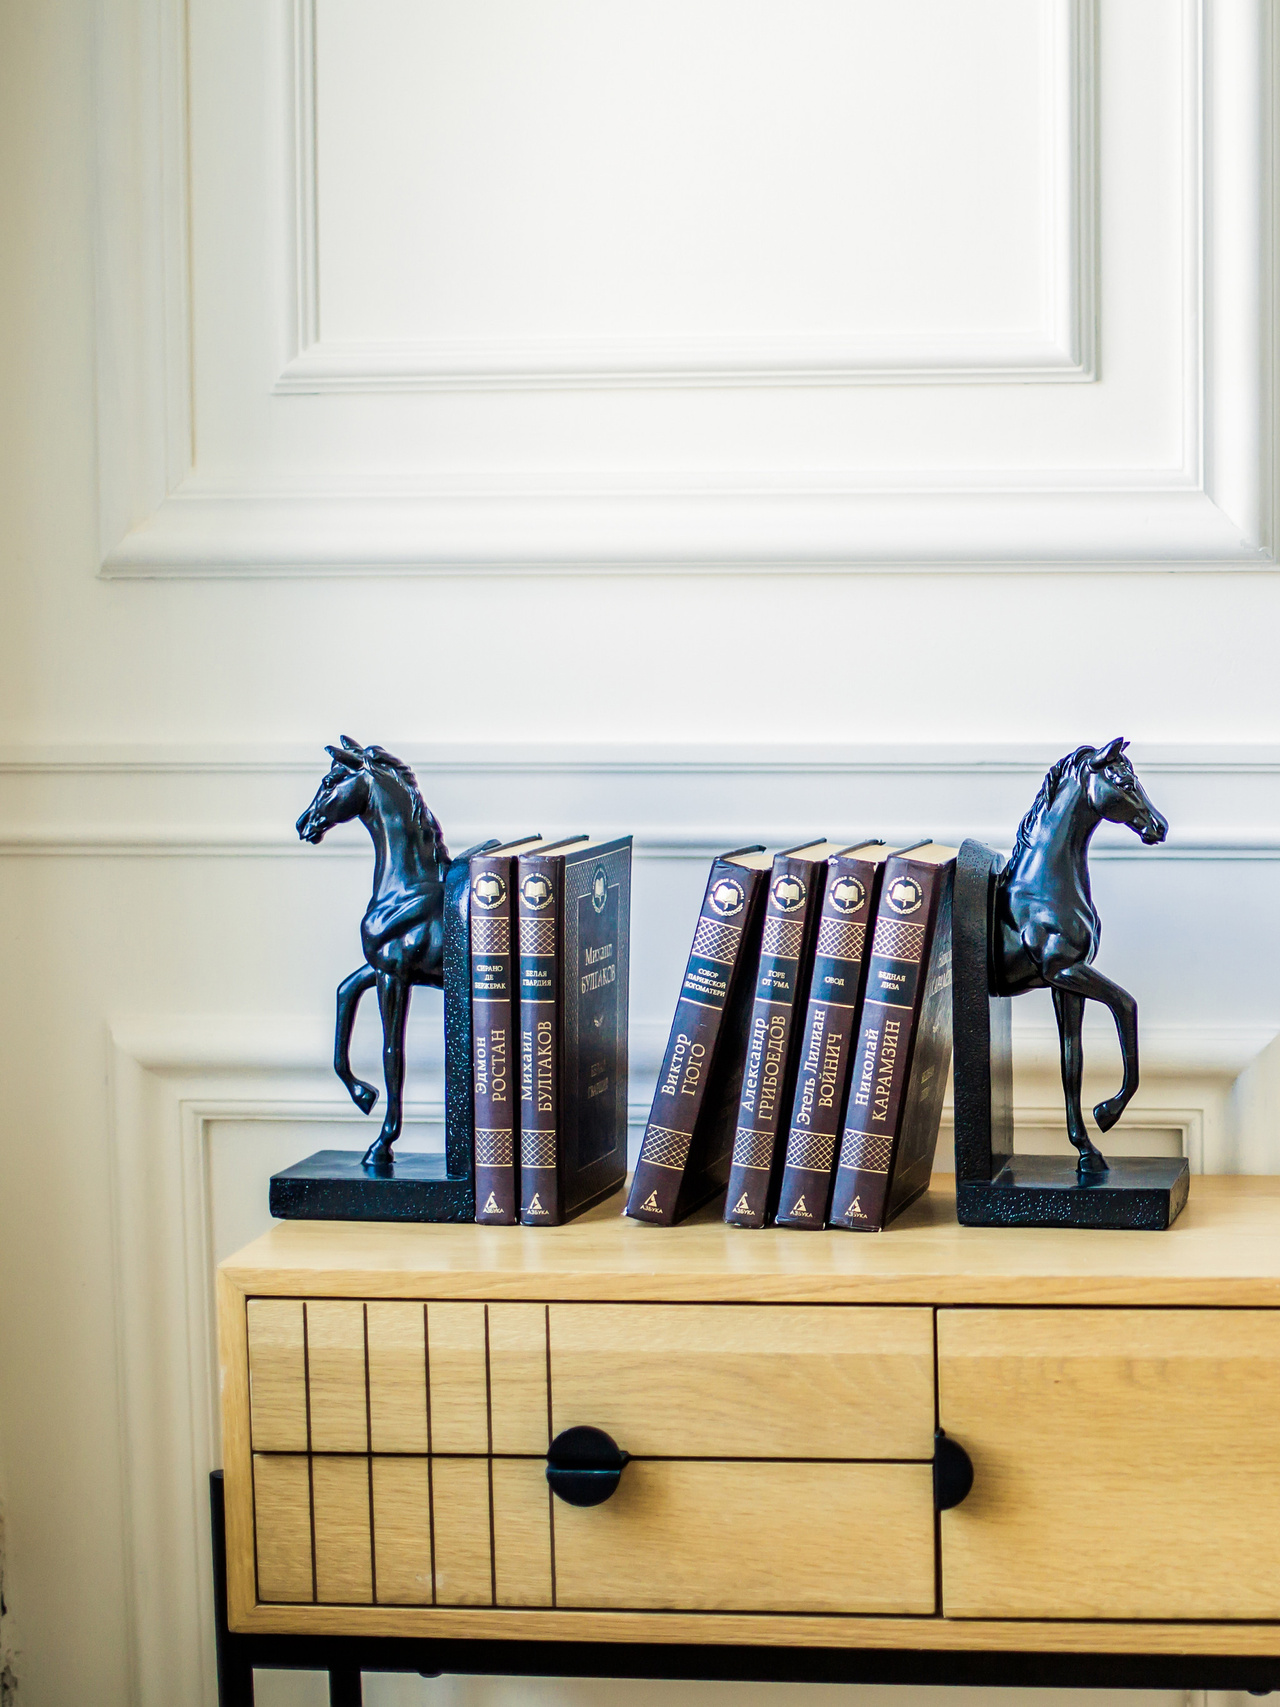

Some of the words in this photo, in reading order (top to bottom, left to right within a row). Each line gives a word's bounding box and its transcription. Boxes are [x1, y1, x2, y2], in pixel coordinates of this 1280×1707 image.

[522, 978, 552, 987] ГВАРДИЯ
[581, 964, 616, 994] БУЛГАКОВ
[687, 973, 726, 990] ПАРИЖСКОЙ
[698, 968, 719, 979] СОБОР
[762, 978, 772, 986] ОТ
[772, 980, 790, 990] УМА
[768, 970, 786, 979] ГОРЕ
[824, 976, 845, 986] ОВОД
[878, 970, 906, 982] БЕДНАЯ
[880, 981, 900, 991] ЛИЗА
[684, 980, 726, 998] БОГОМАТЕРИ
[803, 1009, 826, 1074] Лилиан
[475, 1036, 488, 1094] Эдмон
[491, 1029, 506, 1102] РОСТАН
[521, 1031, 533, 1102] Михаил
[538, 1021, 552, 1112] БУЛГАКОВ
[661, 1033, 692, 1096] Виктор
[681, 1043, 706, 1096] ГЮГО
[741, 1017, 770, 1112] Александр
[758, 1015, 786, 1121] ГРИБОЕДОВ
[818, 1032, 842, 1108] ВОЙНИЧ
[854, 1028, 880, 1107] Николай
[872, 1020, 900, 1122] КАРАМЗИН
[796, 1077, 816, 1126] Этель
[640, 1204, 664, 1214] АЗБУКА
[732, 1207, 756, 1216] АЗБУКА
[790, 1210, 813, 1218] АЗБУКА
[844, 1211, 868, 1219] АЗБУКА
